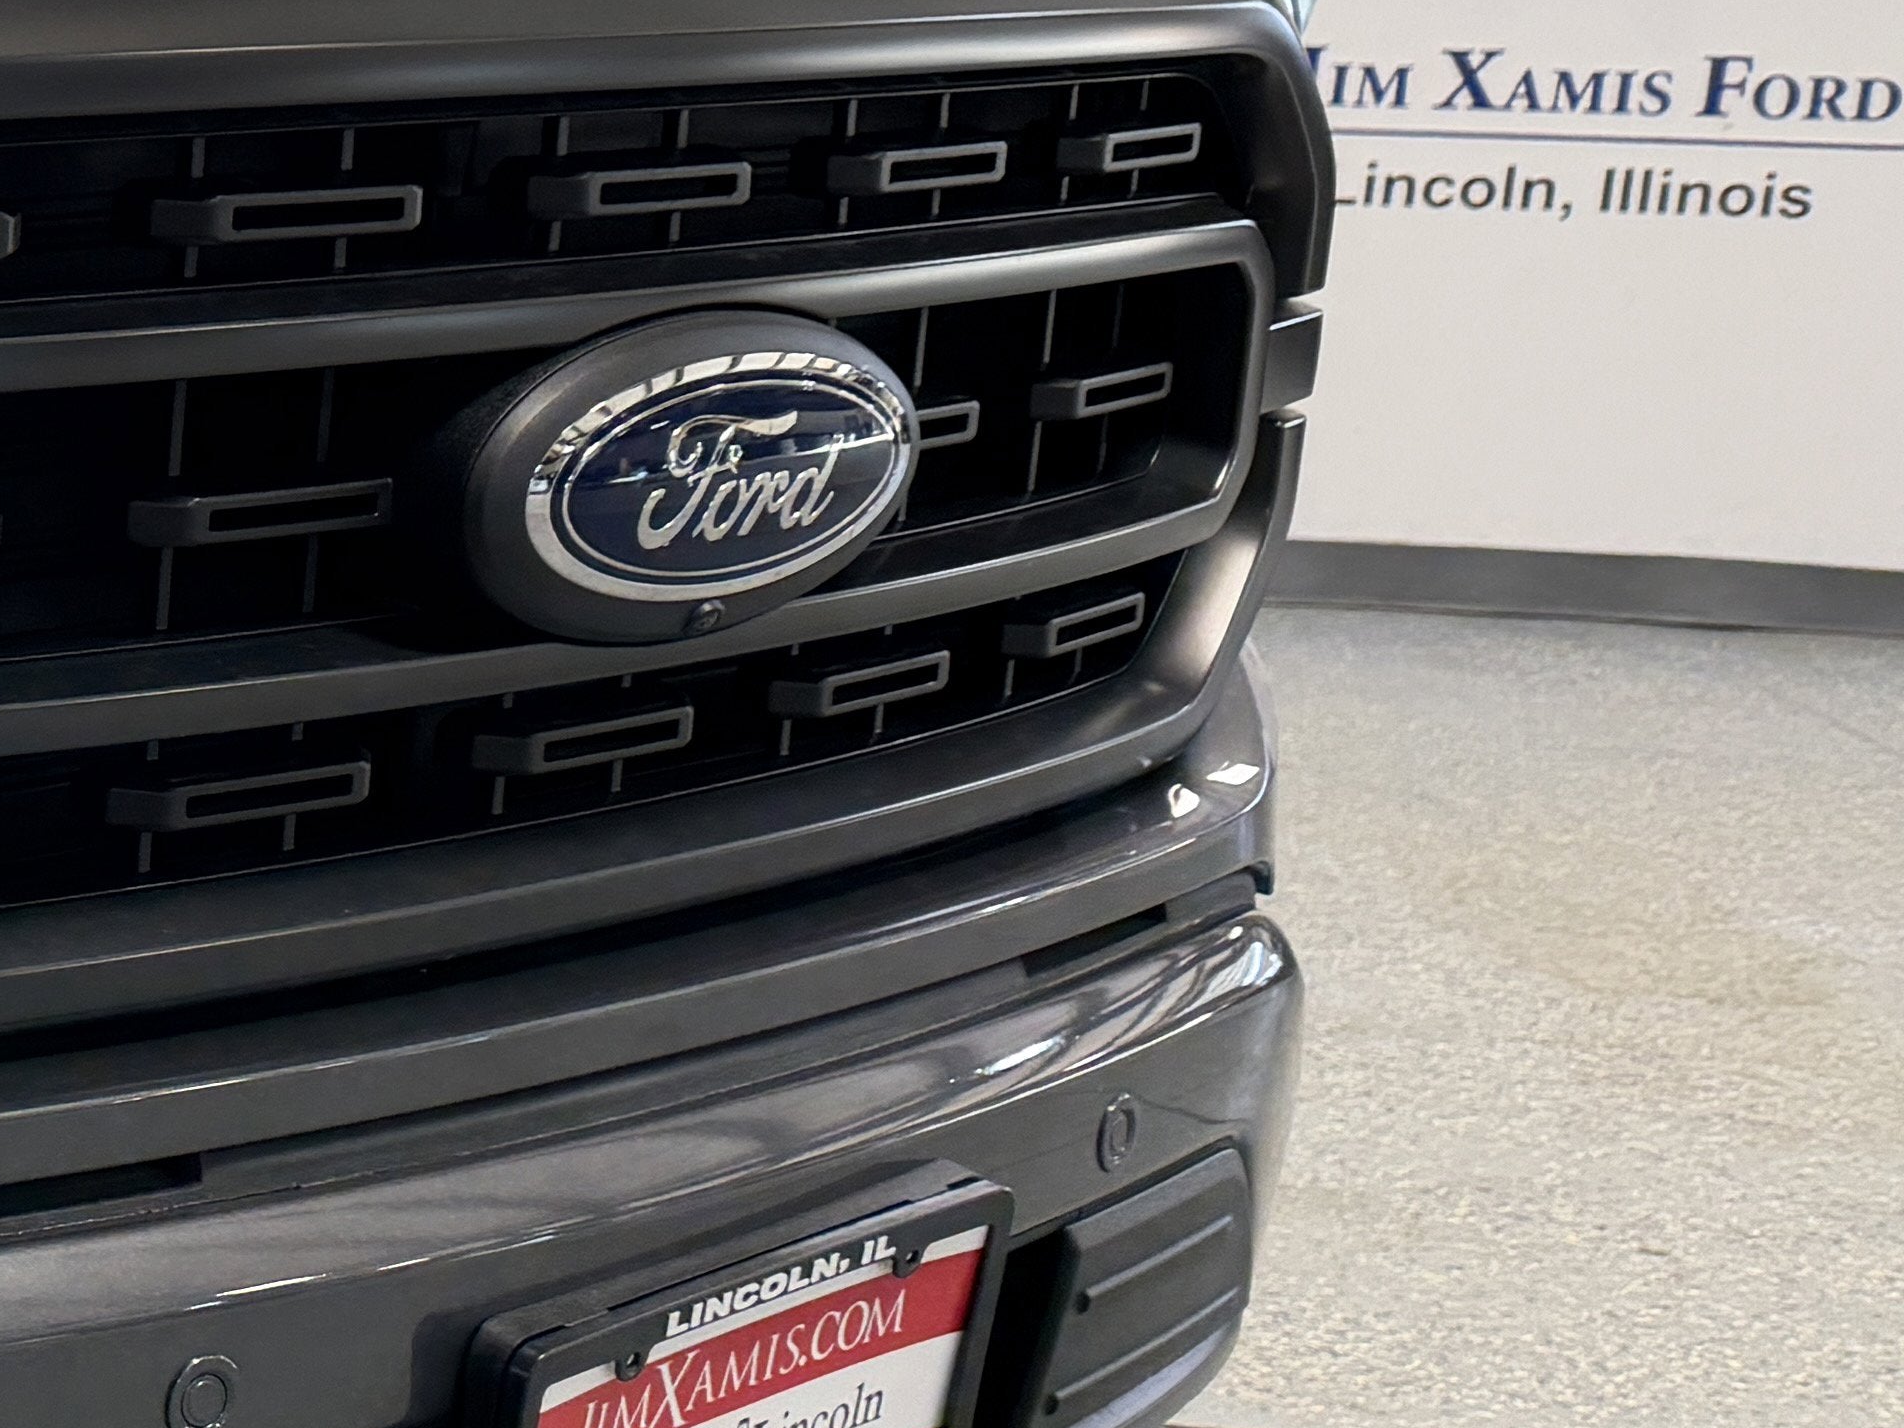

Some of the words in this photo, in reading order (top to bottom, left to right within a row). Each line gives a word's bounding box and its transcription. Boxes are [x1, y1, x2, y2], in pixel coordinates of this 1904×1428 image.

[1432, 45, 1673, 118] XAMIS
[1694, 54, 1904, 124] FORD
[1335, 160, 1573, 221] incoln,
[1598, 165, 1814, 220] Illinois
[636, 409, 846, 551] Ford
[665, 1251, 851, 1338] LINCOLN,
[860, 1234, 897, 1266] IL
